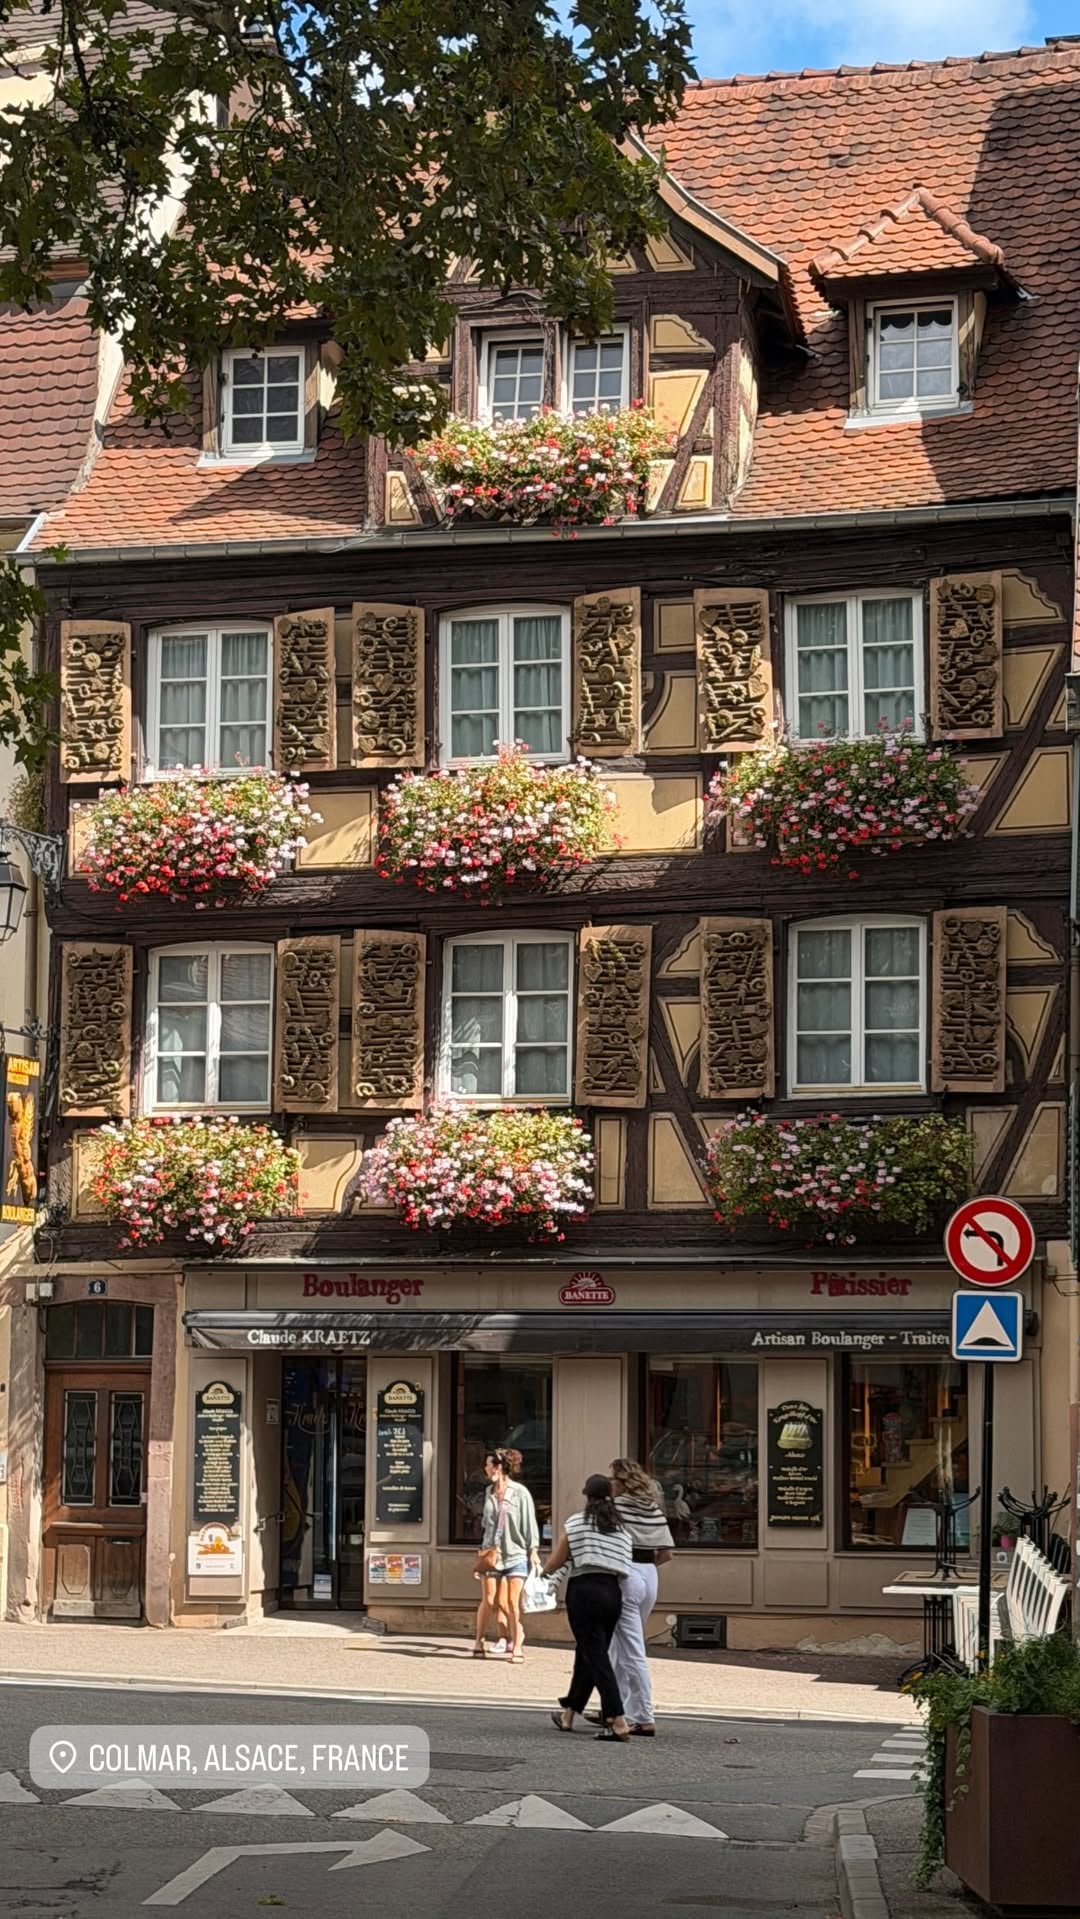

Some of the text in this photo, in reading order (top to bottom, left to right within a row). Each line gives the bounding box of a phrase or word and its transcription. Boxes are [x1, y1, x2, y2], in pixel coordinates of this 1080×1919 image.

[7, 1056, 40, 1076] ARTISAN
[94, 1281, 101, 1293] 6
[303, 1273, 424, 1304] Boulanger
[564, 1291, 609, 1300] BANETTE
[248, 1329, 371, 1345] Claude KRAETZ
[752, 1331, 806, 1346] Artisan
[811, 1331, 885, 1350] Boulanger
